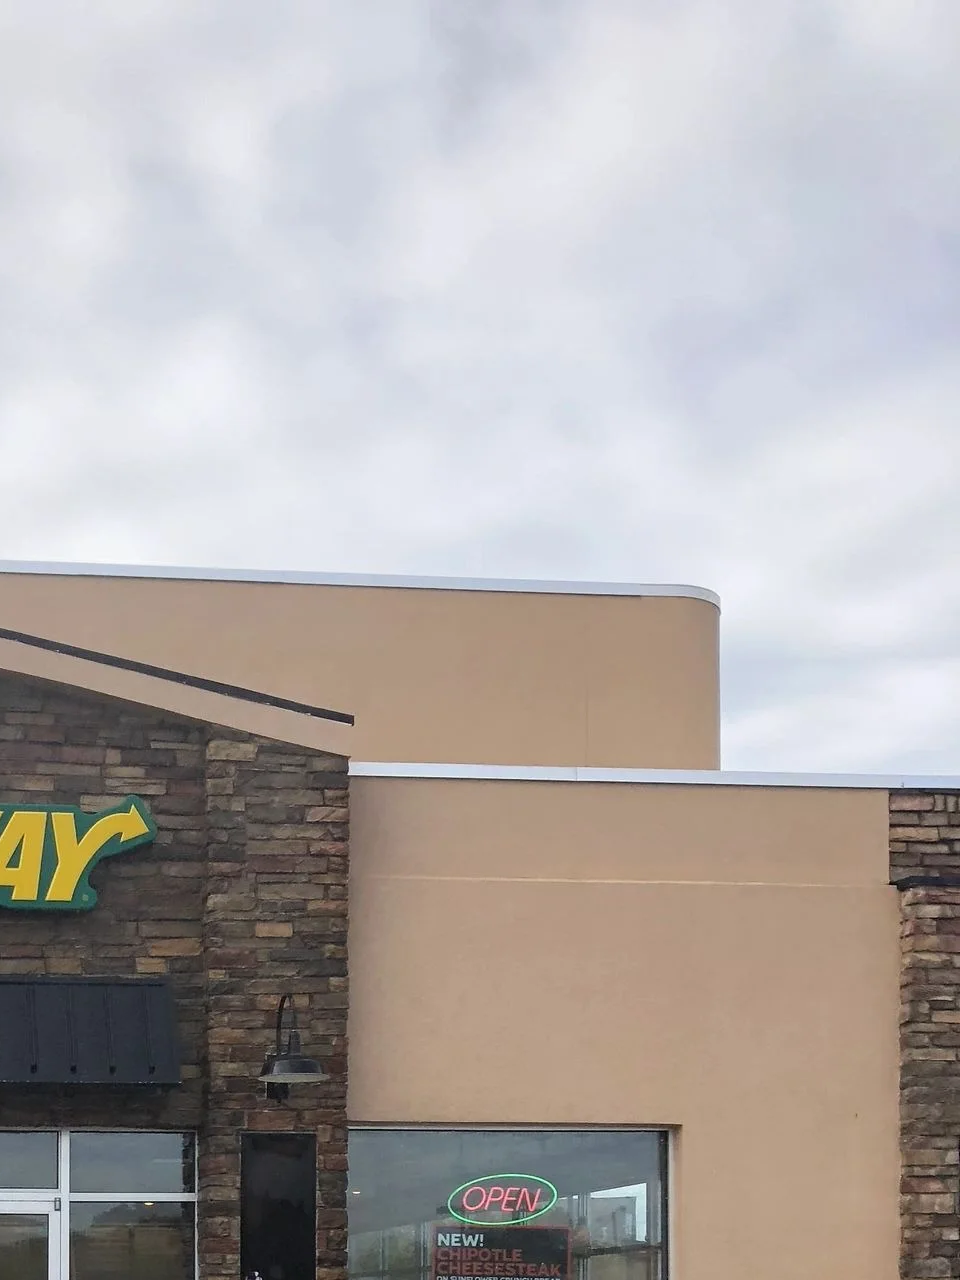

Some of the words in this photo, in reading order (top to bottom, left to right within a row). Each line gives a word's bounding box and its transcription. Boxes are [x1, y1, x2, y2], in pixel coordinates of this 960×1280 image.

[463, 1186, 541, 1211] OPEN
[437, 1233, 484, 1247] NEW!
[436, 1248, 522, 1262] CHIPOTLE
[436, 1262, 561, 1276] CHEESESTEAK
